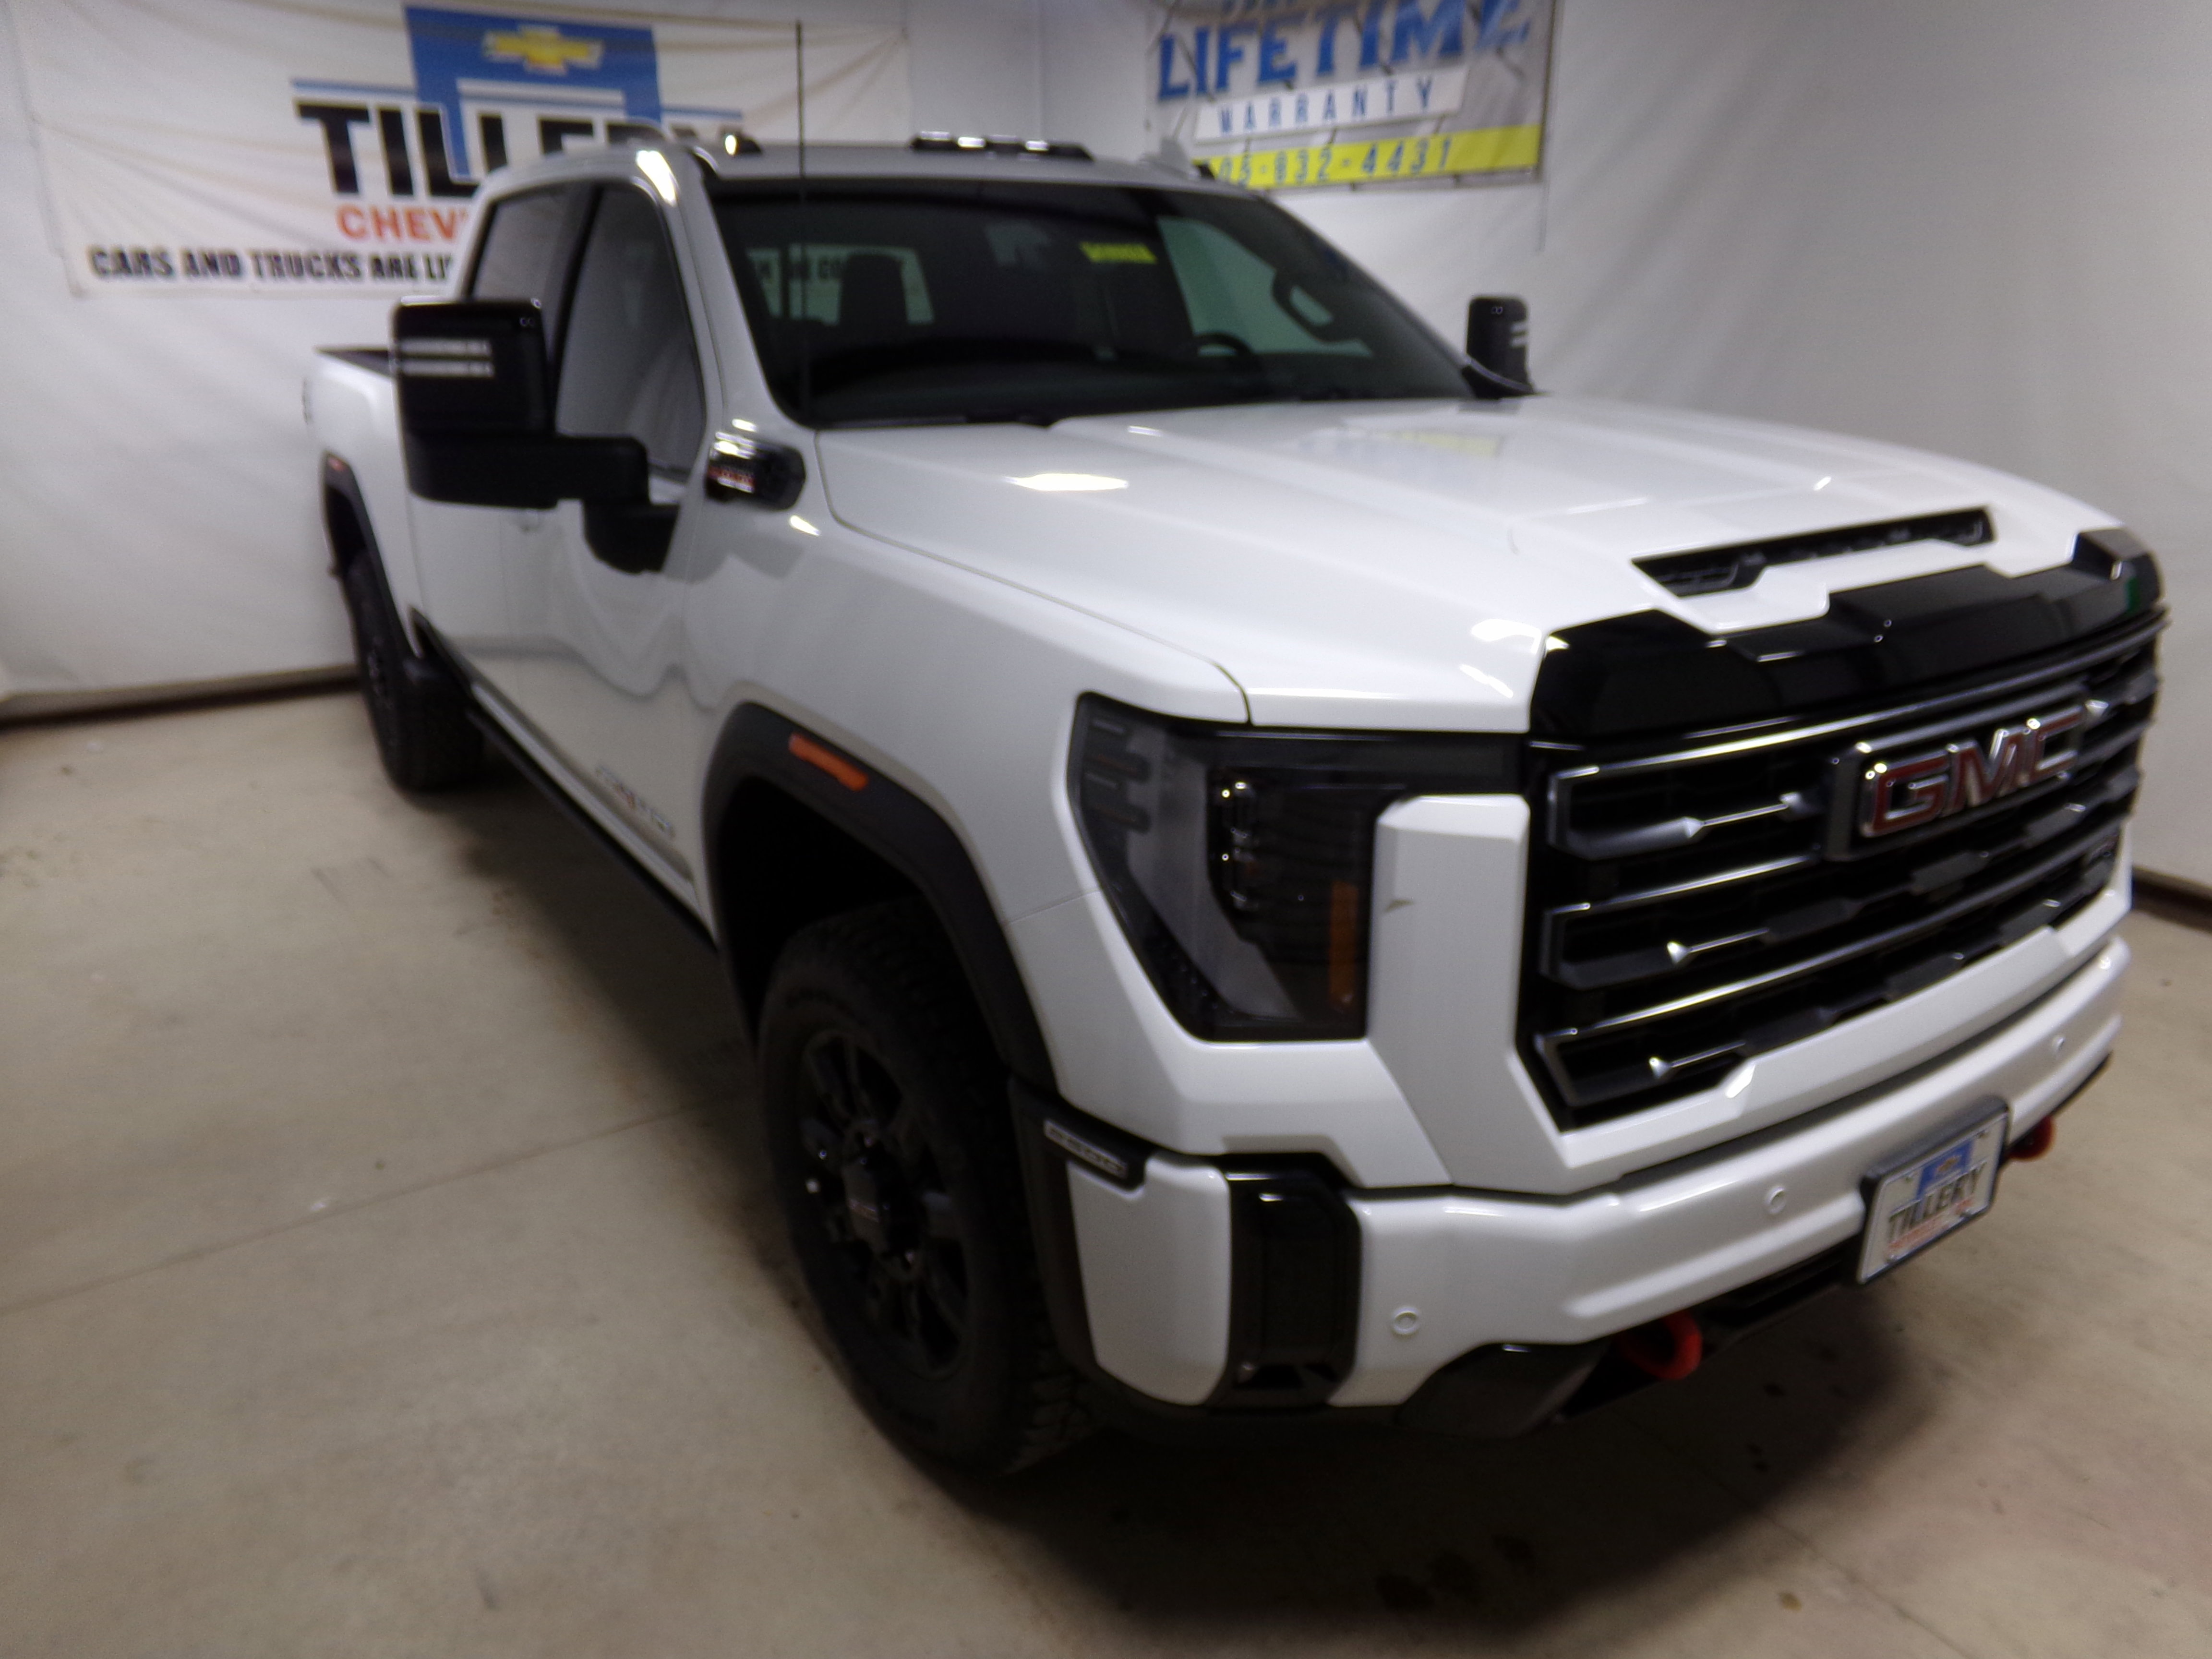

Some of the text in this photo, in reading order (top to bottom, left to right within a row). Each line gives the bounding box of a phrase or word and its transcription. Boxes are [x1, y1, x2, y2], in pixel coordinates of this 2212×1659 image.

[1218, 76, 1433, 134] WARRANTY
[89, 247, 174, 278] CARS
[180, 250, 244, 278] AND
[250, 252, 362, 280] TRUCKS
[369, 254, 419, 281] ARE
[1859, 705, 2083, 838] GMC
